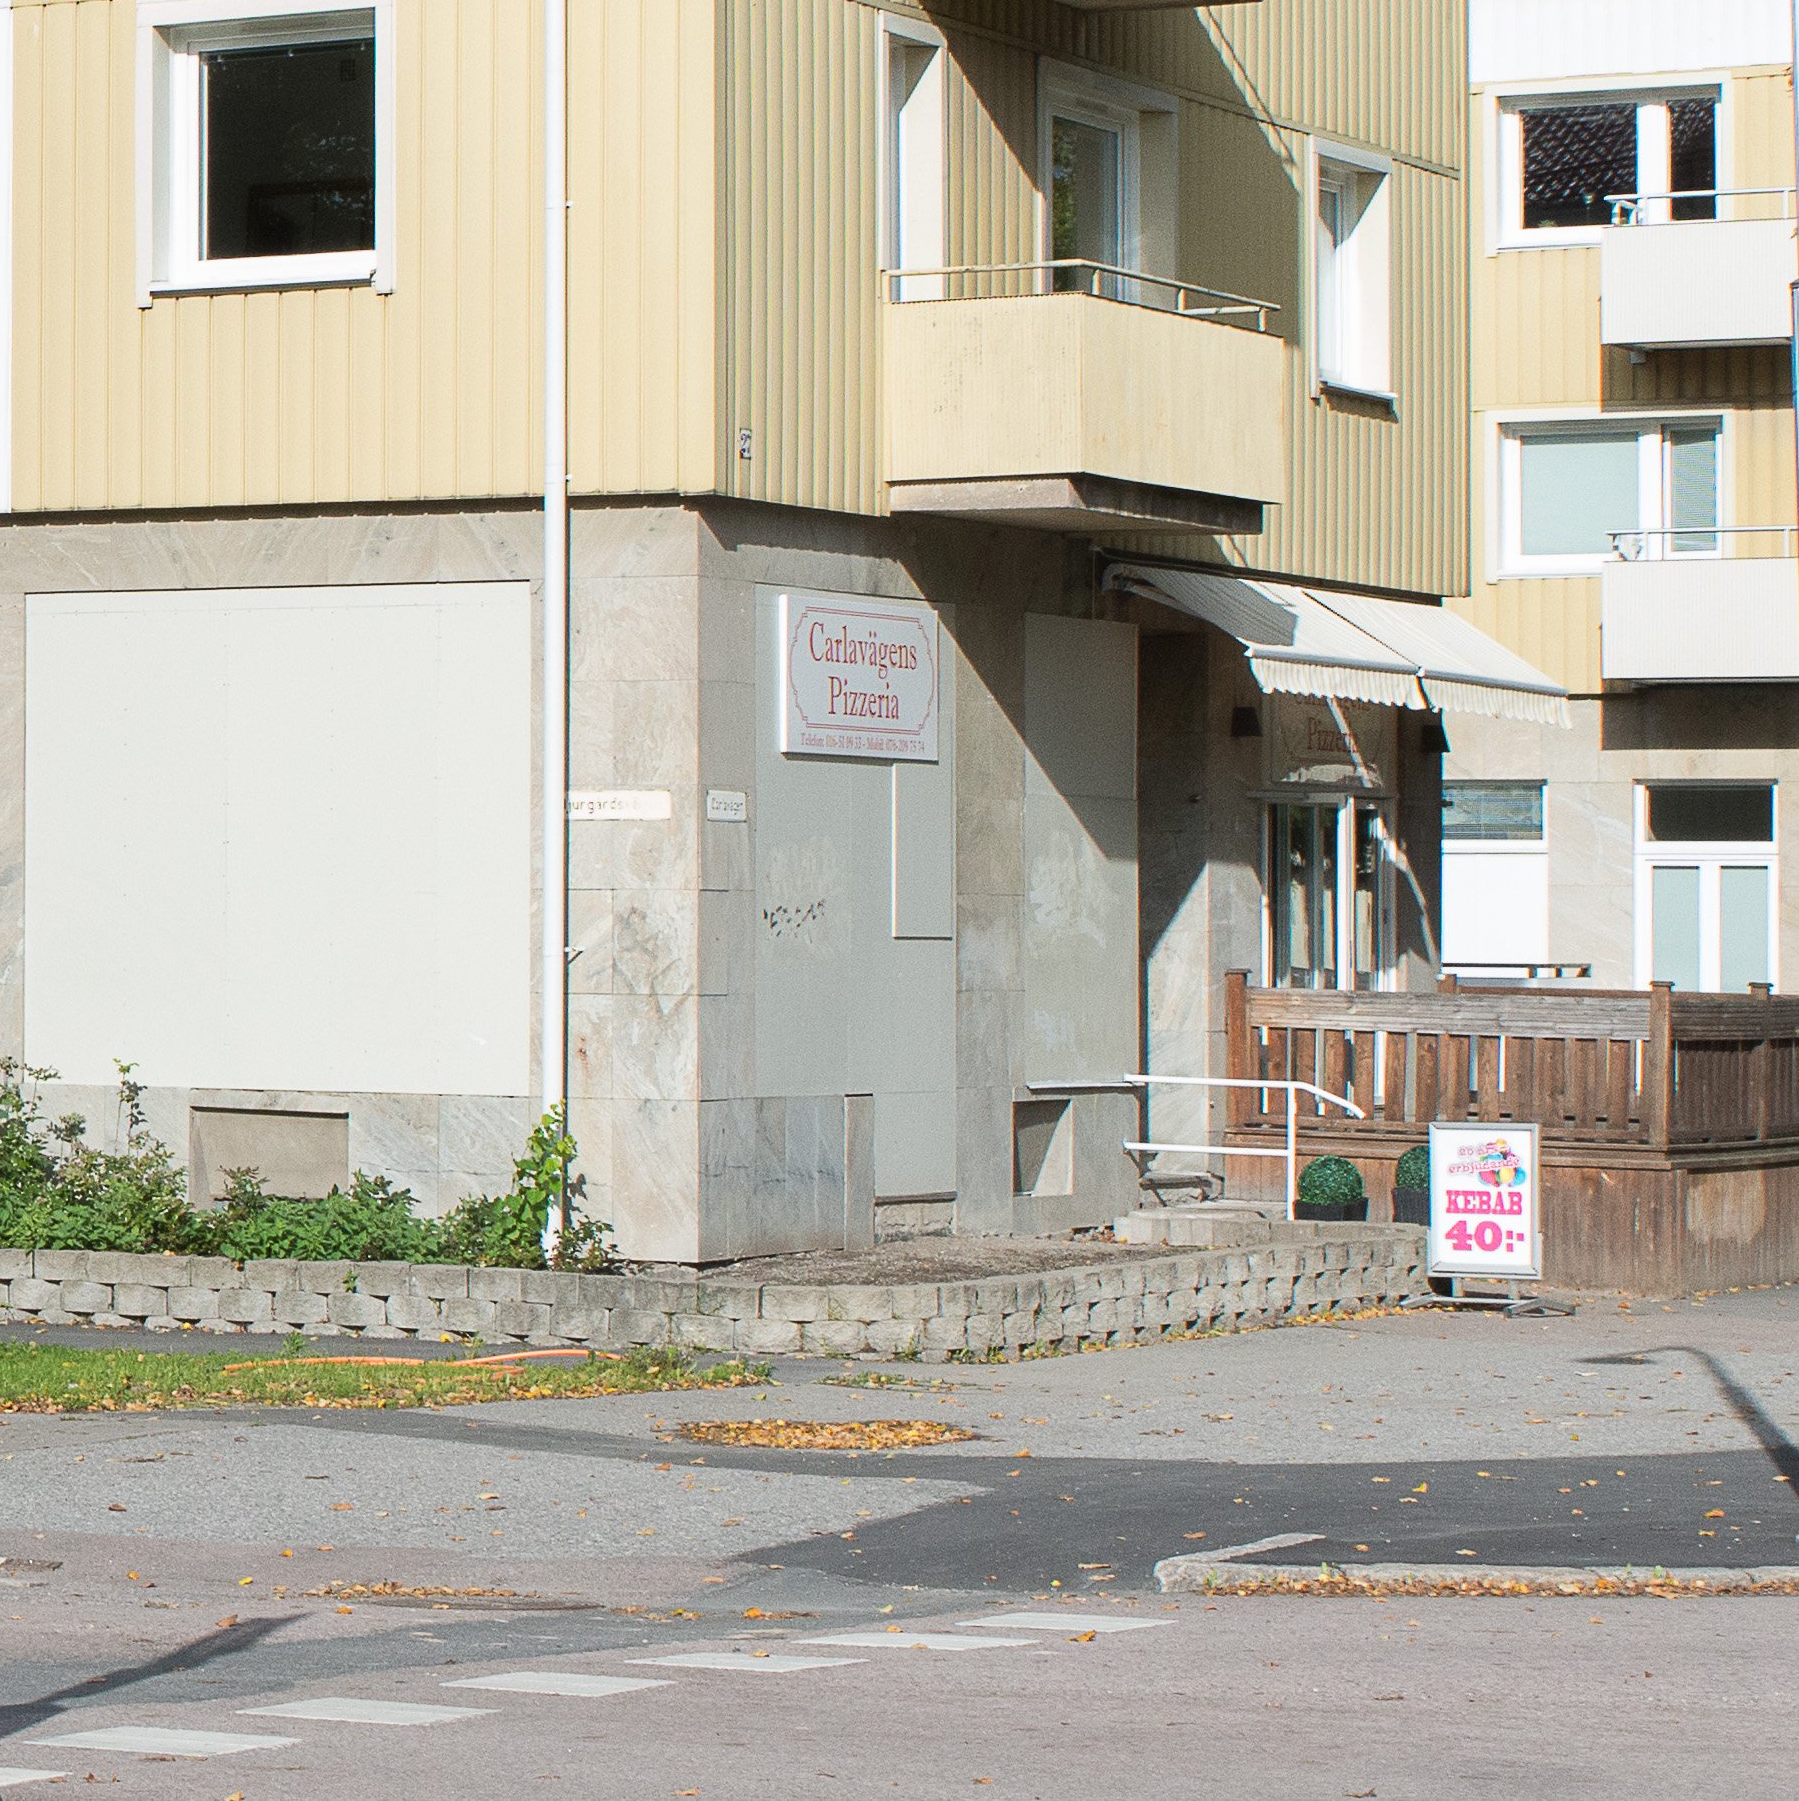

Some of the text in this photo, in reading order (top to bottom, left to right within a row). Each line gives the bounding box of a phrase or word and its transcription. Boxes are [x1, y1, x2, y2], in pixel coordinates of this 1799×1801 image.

[809, 622, 918, 679] Carlavägens
[828, 676, 899, 720] Pizzeria
[1445, 1190, 1522, 1215] KEBAB
[1445, 1220, 1524, 1252] 40:-
